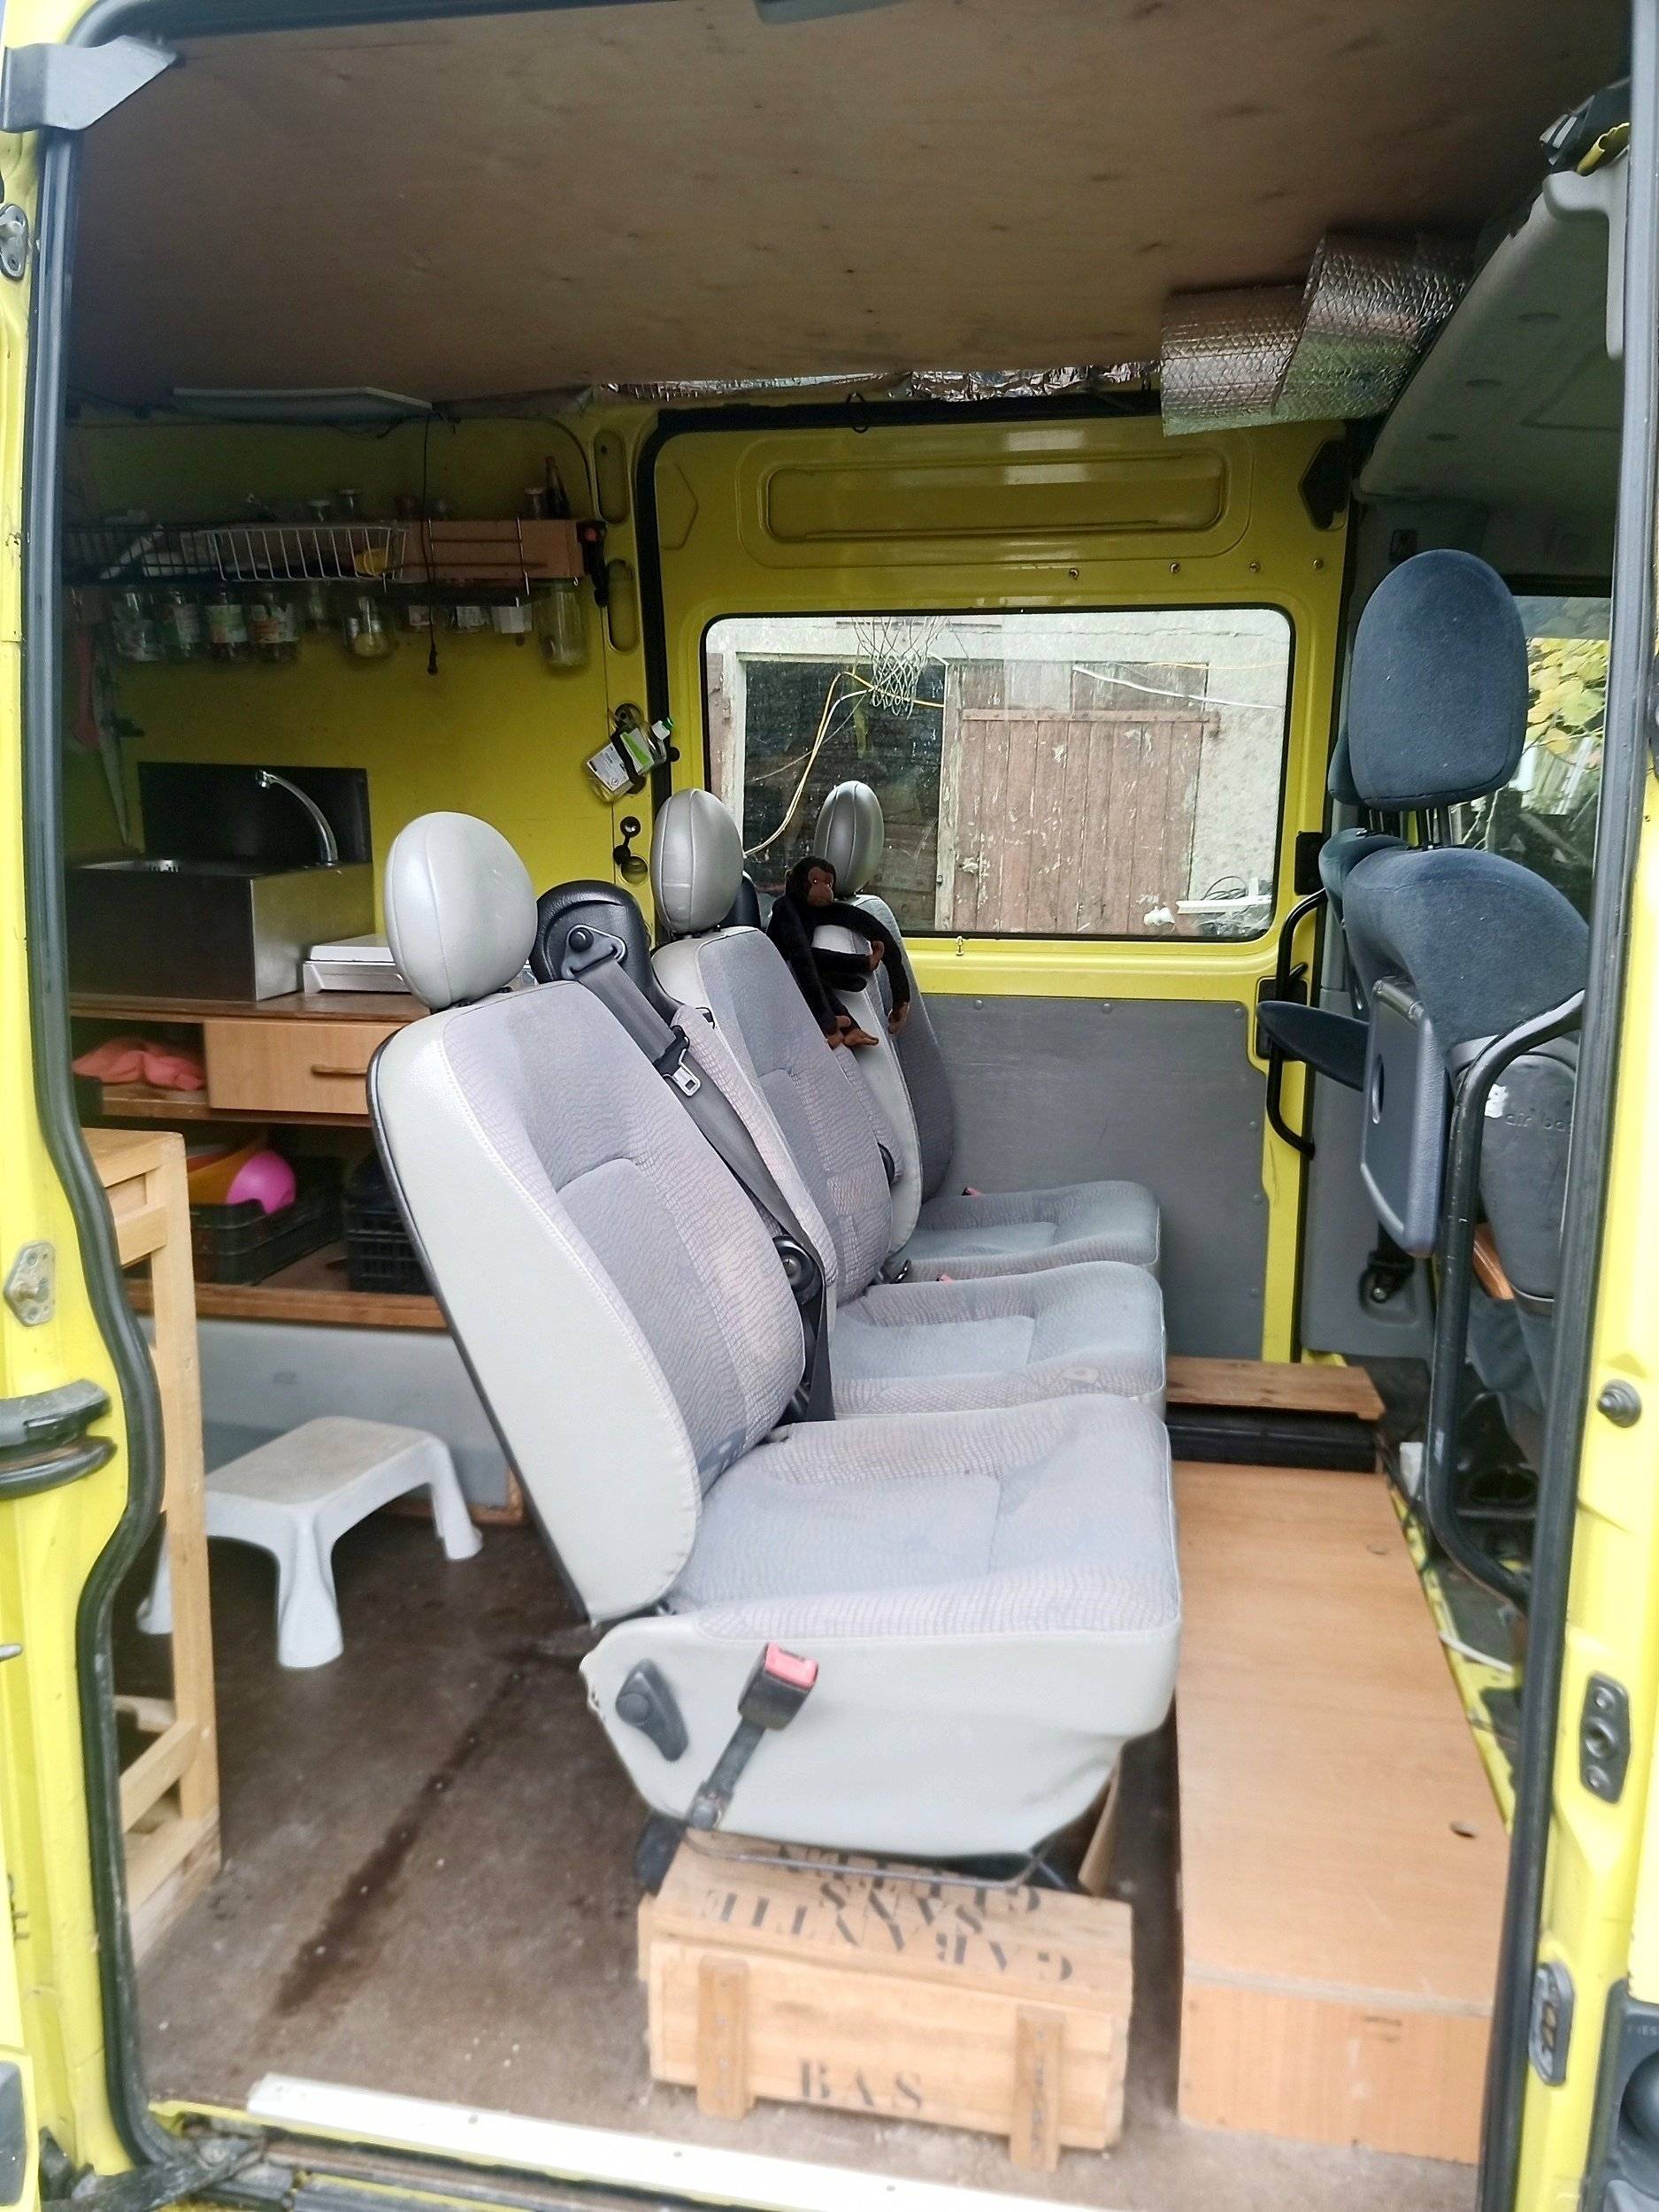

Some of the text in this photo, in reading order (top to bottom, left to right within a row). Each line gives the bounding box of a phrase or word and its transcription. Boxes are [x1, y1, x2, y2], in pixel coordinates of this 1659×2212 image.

[1540, 1111, 1571, 1135] ba
[819, 1881, 983, 1935] SANS
[699, 1888, 1073, 1981] GARANTIE
[799, 2059, 924, 2109] BAS
